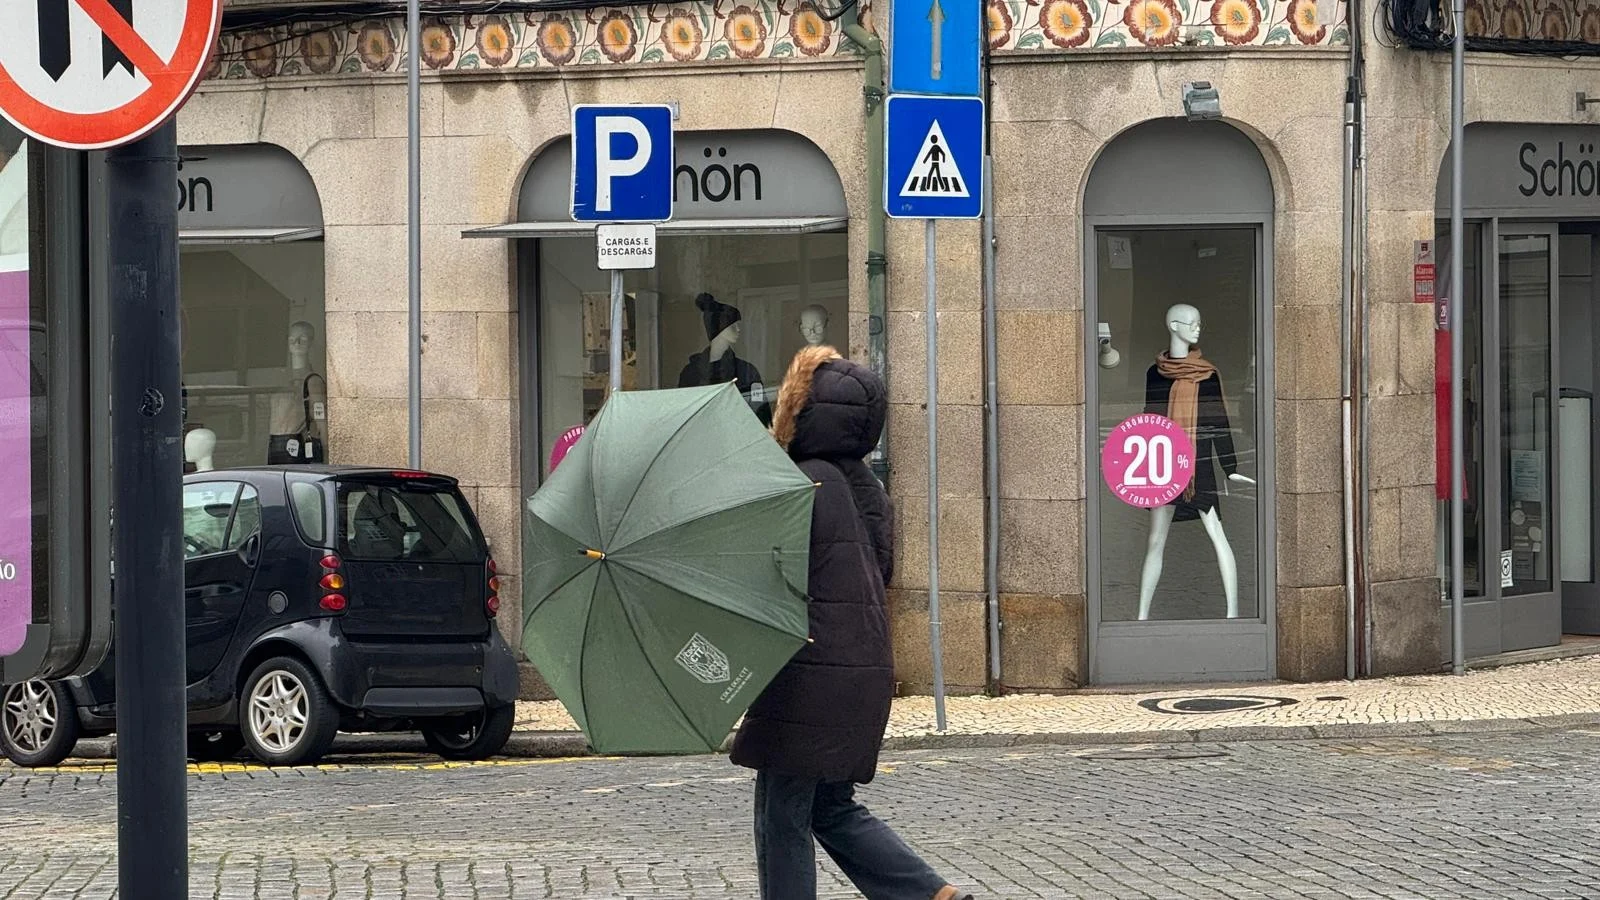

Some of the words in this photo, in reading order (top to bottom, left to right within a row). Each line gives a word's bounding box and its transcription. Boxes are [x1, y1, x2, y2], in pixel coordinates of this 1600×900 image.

[595, 116, 652, 212] P
[1518, 142, 1600, 197] Schö
[605, 238, 641, 246] CARGAS
[601, 247, 653, 256] DESCARGAS
[1120, 415, 1173, 432] PROMOÇÕES
[1115, 483, 1128, 495] EM
[1128, 494, 1150, 505] TODA
[1162, 482, 1181, 501] LOJA
[690, 647, 705, 663] CTT
